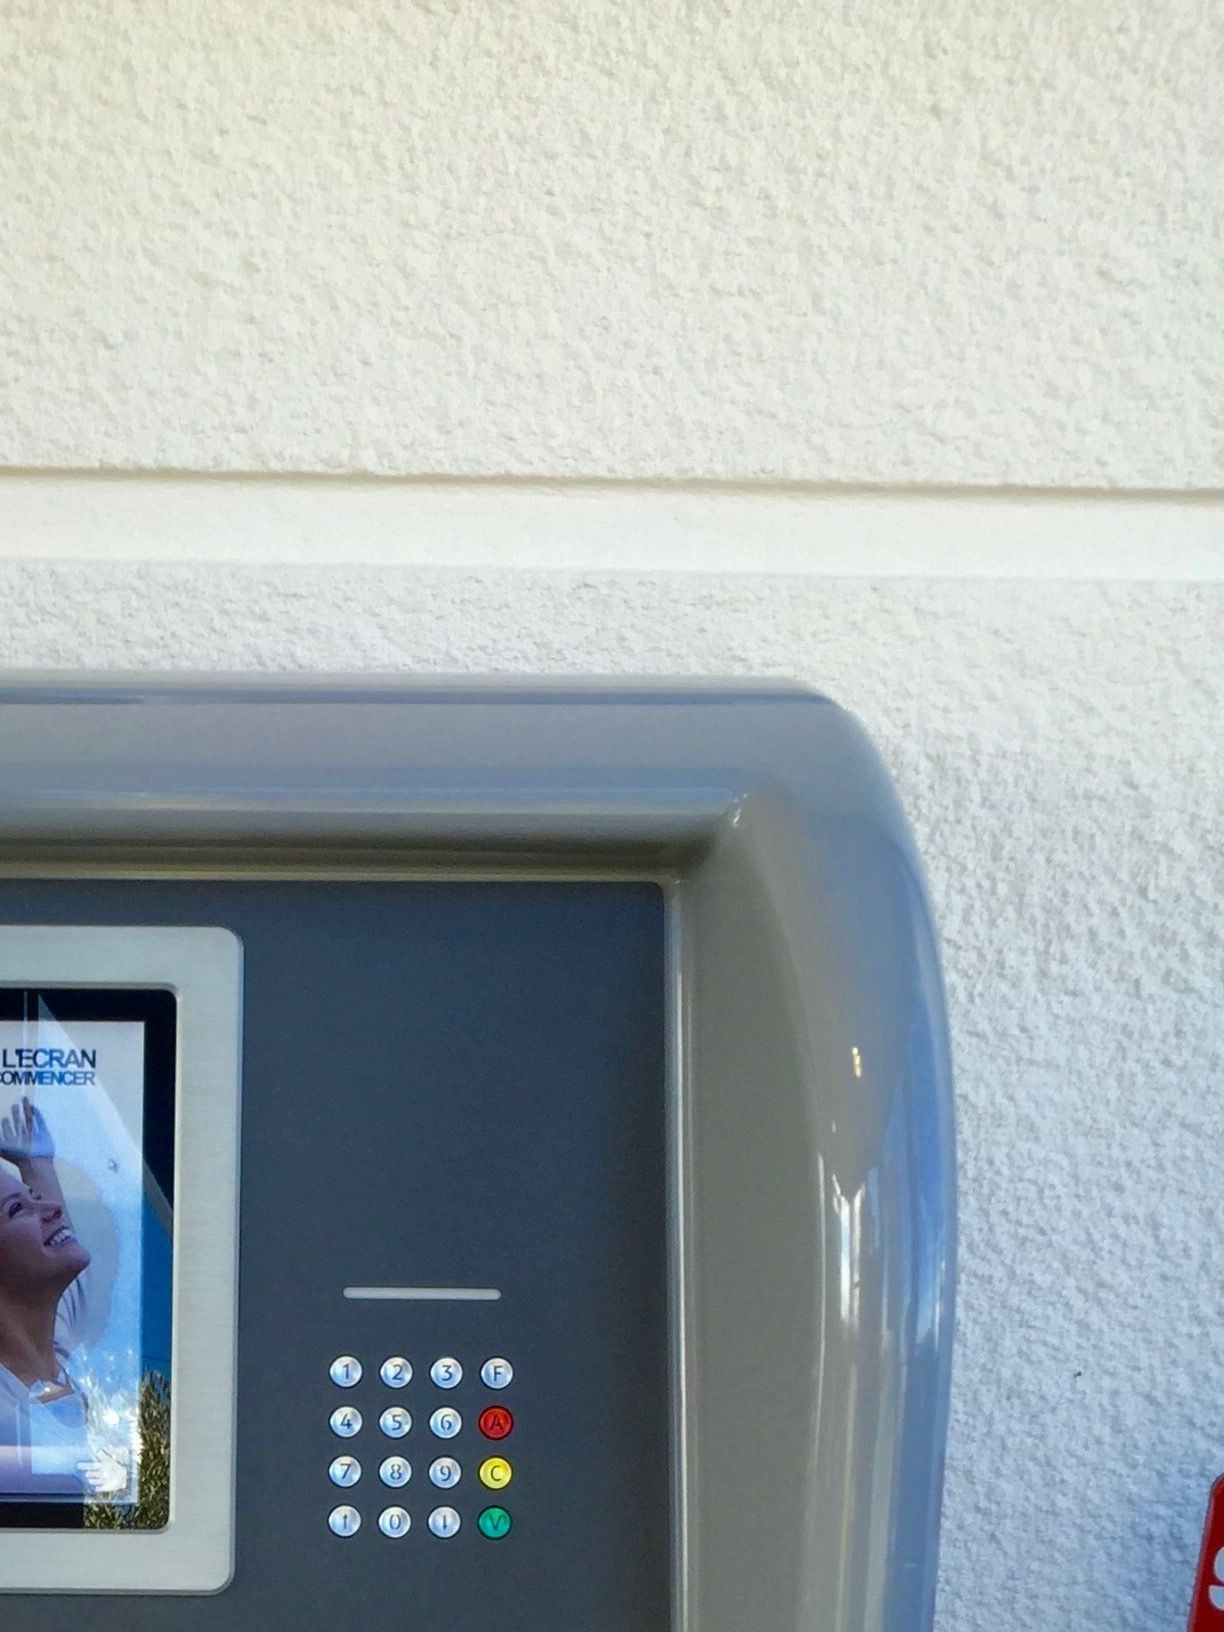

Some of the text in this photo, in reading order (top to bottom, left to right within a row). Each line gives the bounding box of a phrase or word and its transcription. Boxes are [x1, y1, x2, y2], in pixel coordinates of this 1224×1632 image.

[2, 1048, 96, 1069] L'ECRAN
[342, 1363, 503, 1382] 1 2 3 F
[340, 1414, 504, 1432] 4 5 6 A
[340, 1463, 502, 1482] 7 8 9 C
[389, 1514, 503, 1531] 0 V
